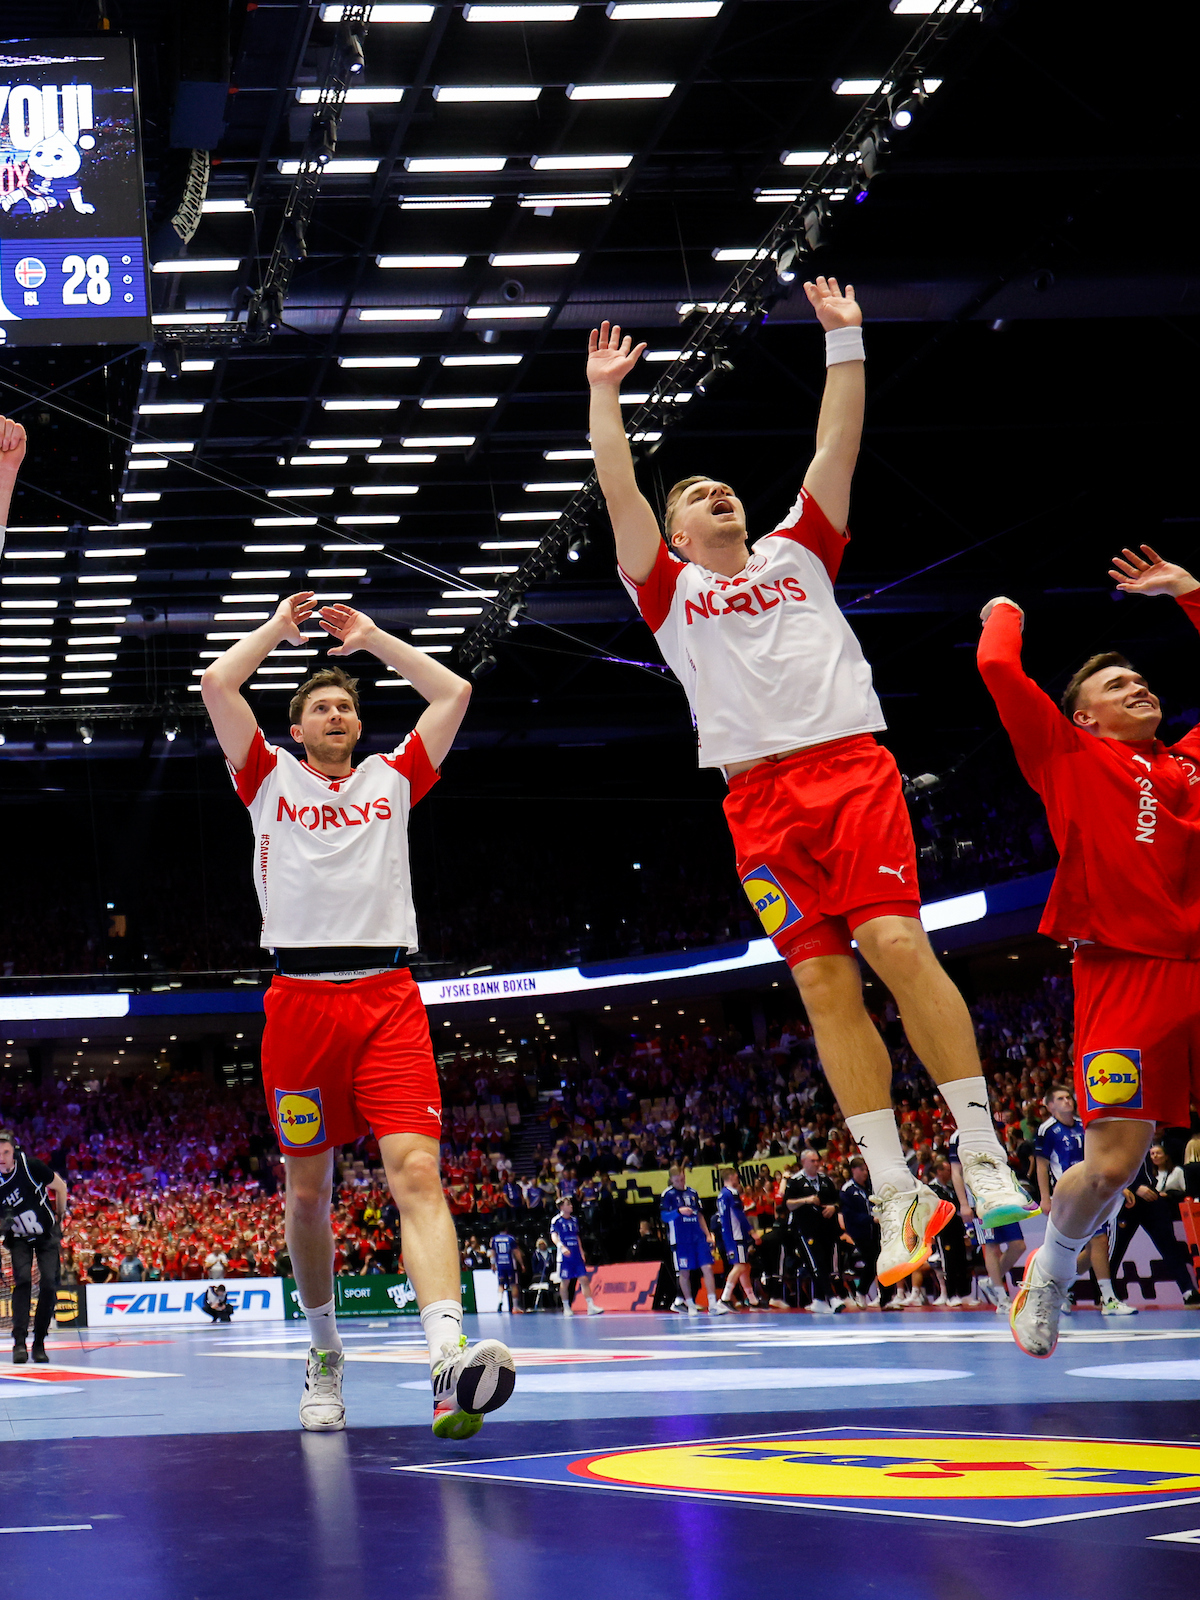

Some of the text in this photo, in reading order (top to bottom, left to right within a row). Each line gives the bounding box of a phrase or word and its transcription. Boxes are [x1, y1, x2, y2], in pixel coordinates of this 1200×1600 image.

[61, 254, 112, 306] 28
[685, 577, 807, 625] NORLYS
[277, 796, 392, 831] NORLYS
[440, 977, 537, 999] JYSKE BANK BOXEN
[344, 1286, 371, 1299] SPORT
